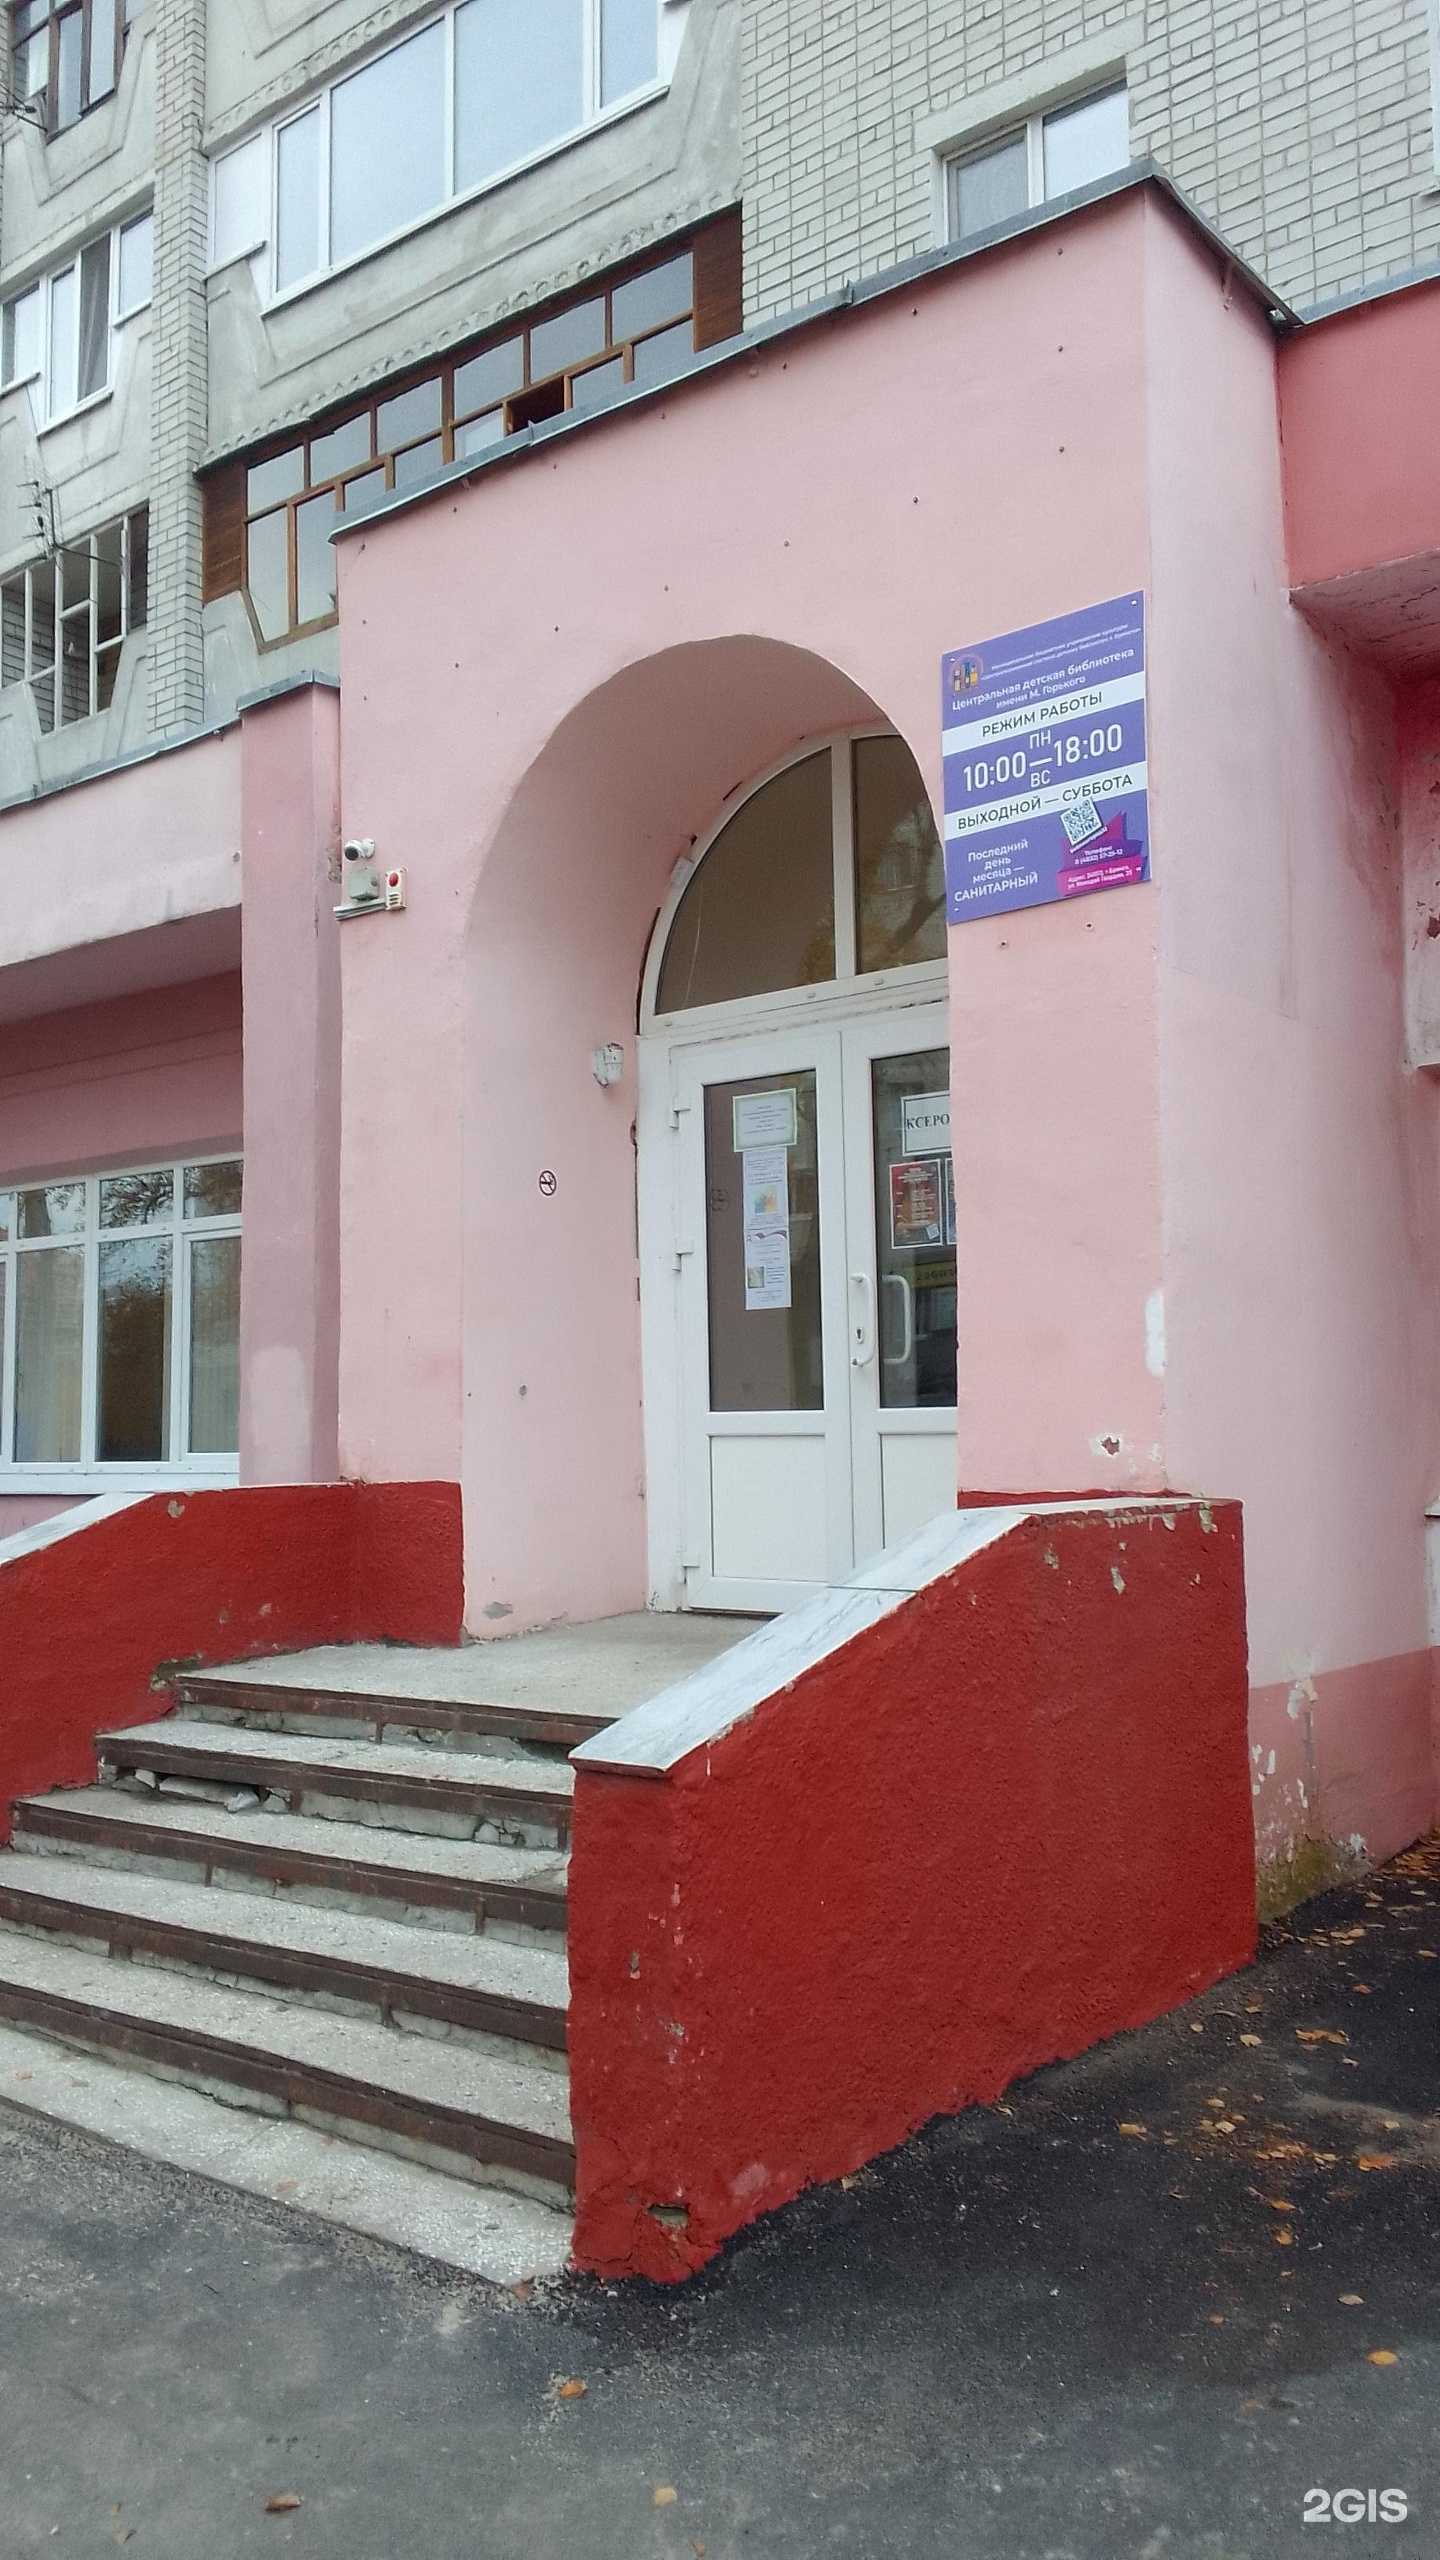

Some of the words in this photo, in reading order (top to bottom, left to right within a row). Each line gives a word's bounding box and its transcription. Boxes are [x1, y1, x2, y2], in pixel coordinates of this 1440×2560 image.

[952, 683, 1020, 711] Центральная
[1022, 669, 1065, 691] детская
[1067, 648, 1136, 675] библиотека
[996, 693, 1028, 709] имени
[1042, 676, 1087, 695] Горького
[982, 711, 1036, 737] РЕЖИМ
[1040, 691, 1103, 720] РАБОТЫ
[1029, 730, 1051, 749] ПН
[963, 751, 1026, 792] 10:00
[1053, 724, 1123, 767] 18:00
[1030, 769, 1051, 788] ВС
[957, 796, 1042, 830] ВЫХОДНОЙ
[1062, 774, 1133, 802] СУББОТА
[967, 839, 1029, 863] Последний
[983, 856, 1012, 871] день
[954, 871, 1039, 902] САНИТАРНЫЙ
[972, 867, 1012, 885] месяца
